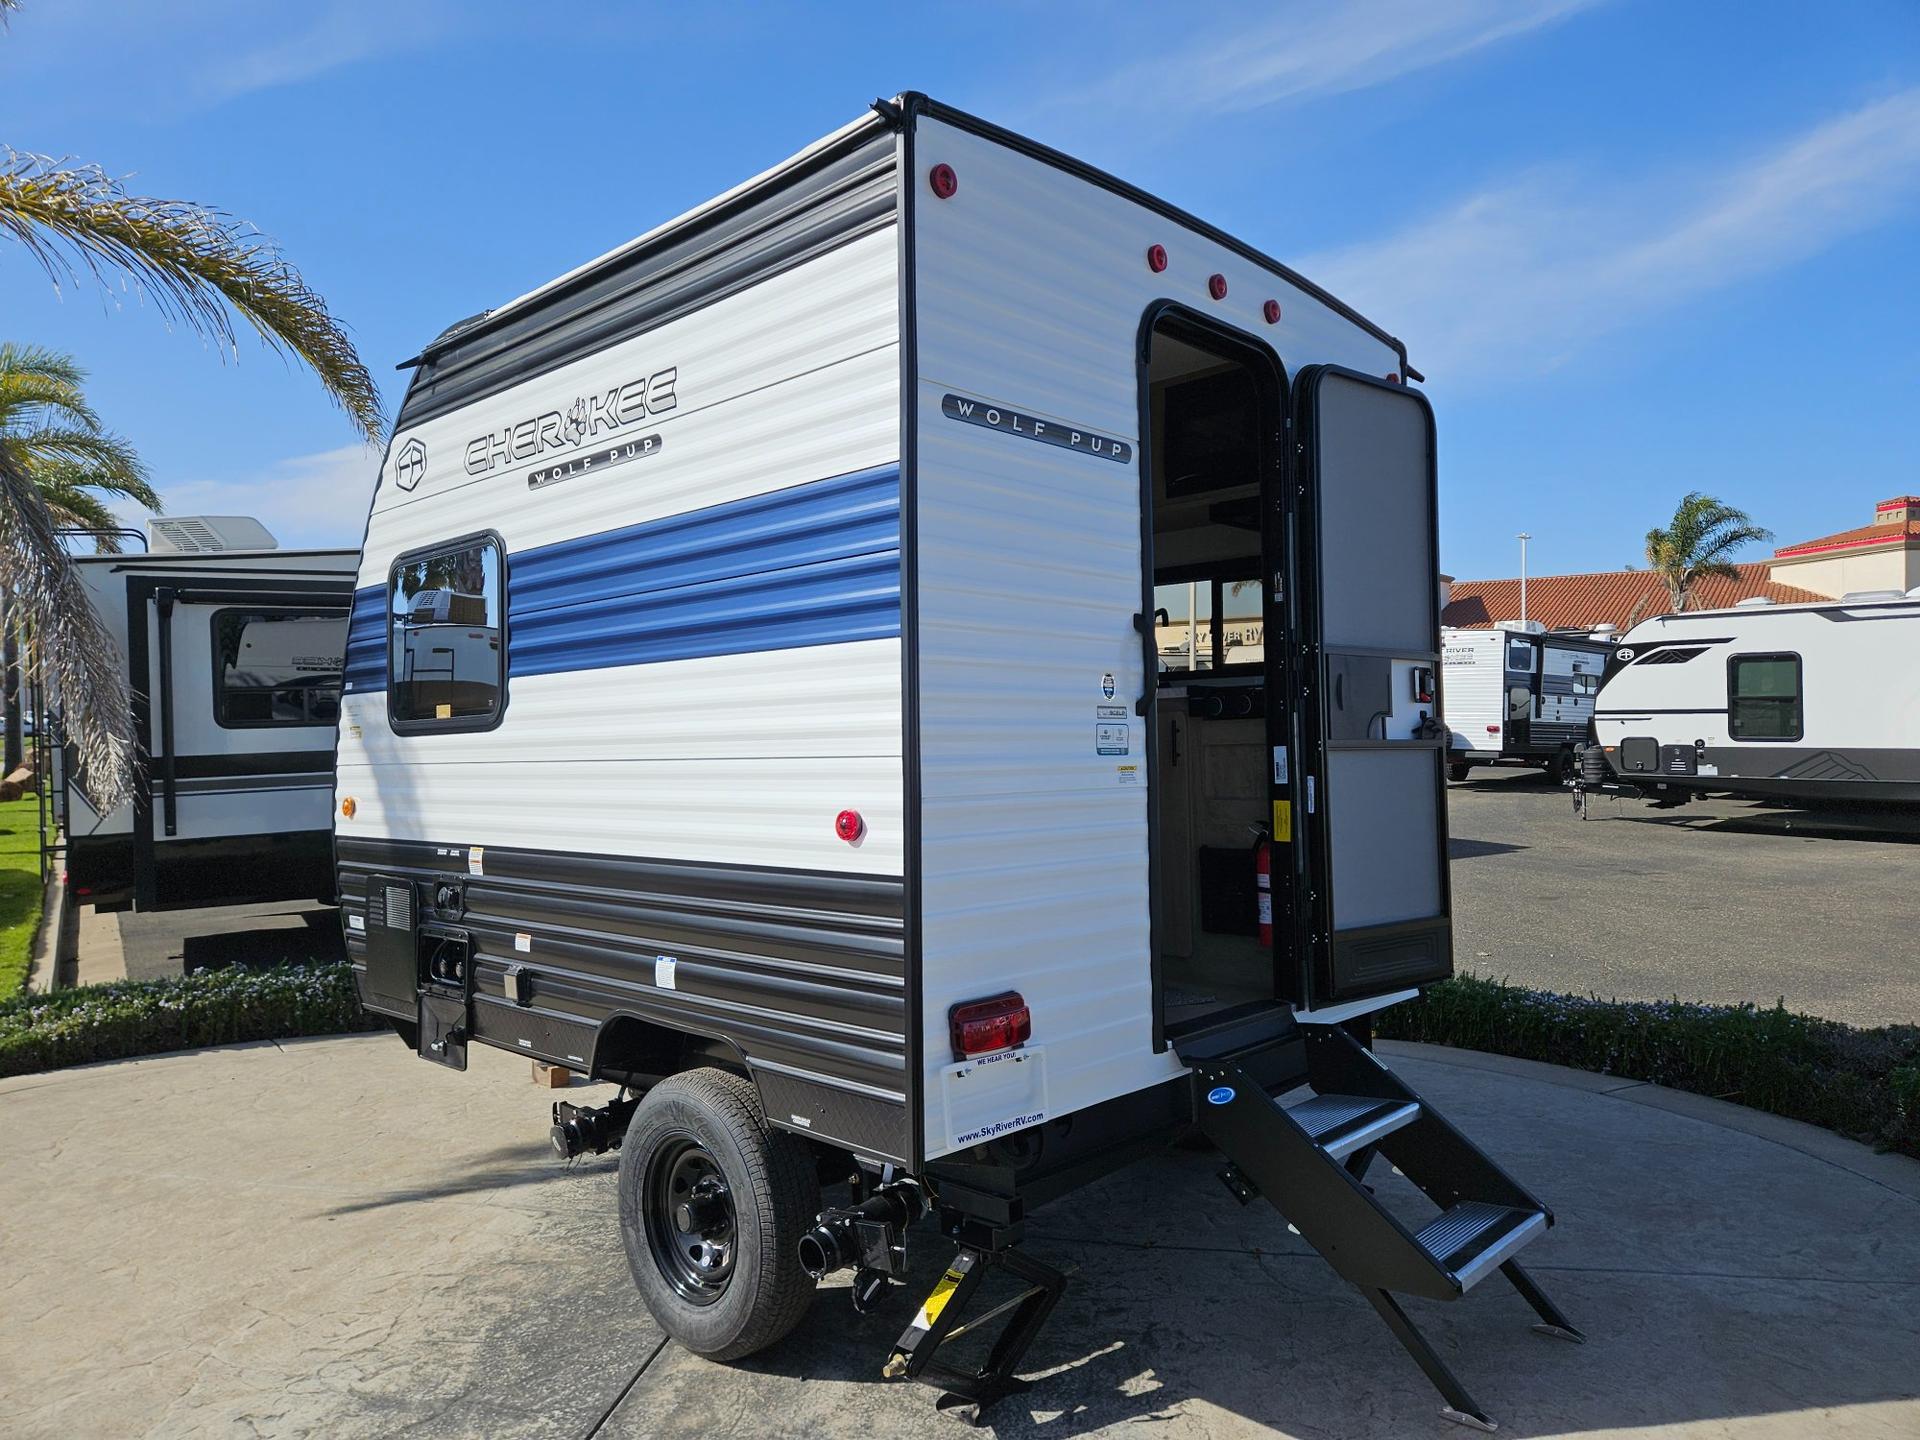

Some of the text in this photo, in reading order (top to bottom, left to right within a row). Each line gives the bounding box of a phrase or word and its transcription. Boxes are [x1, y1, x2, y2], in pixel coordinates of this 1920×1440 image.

[957, 400, 1122, 456] WOLF PUP
[535, 440, 654, 484] WOLF PUP
[977, 1058, 987, 1066] WE
[987, 1054, 1003, 1064] HEAR
[957, 1112, 1044, 1144] www.SkyRiverRV.com
